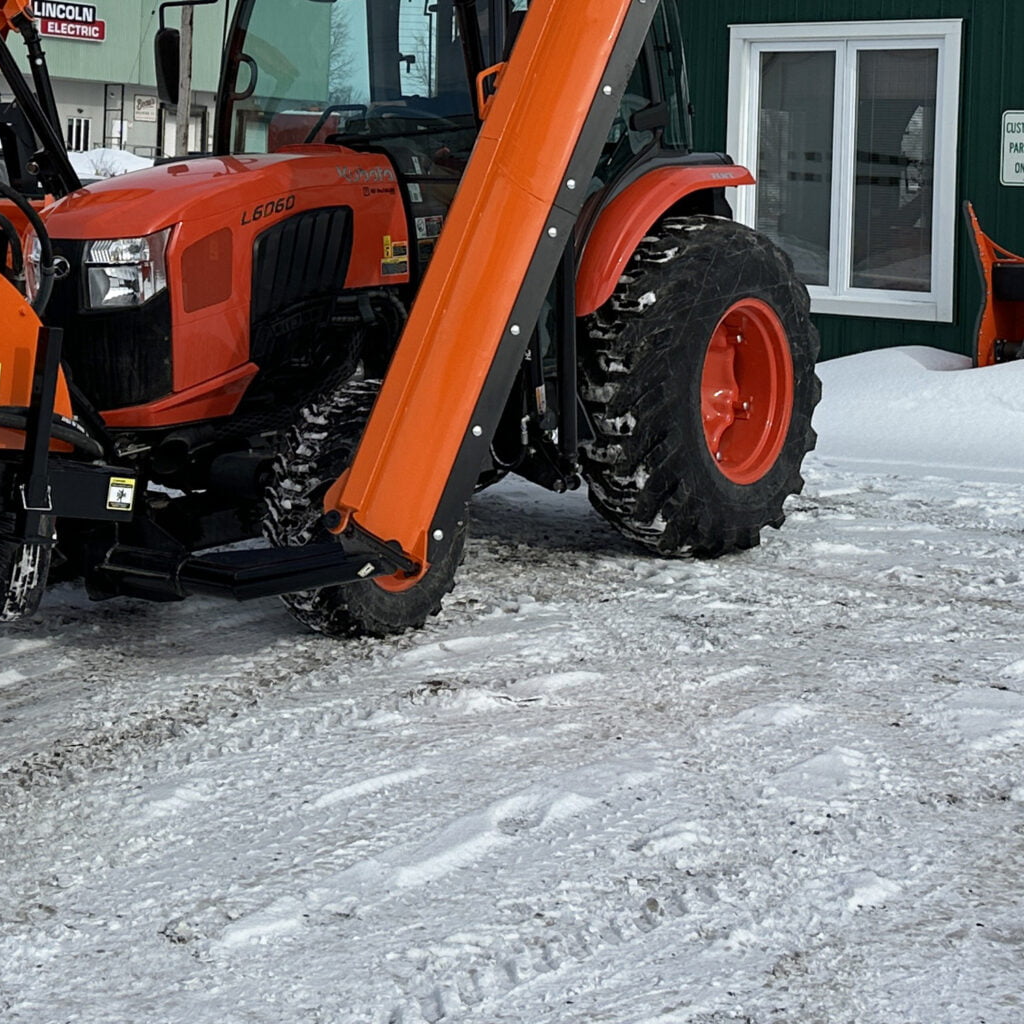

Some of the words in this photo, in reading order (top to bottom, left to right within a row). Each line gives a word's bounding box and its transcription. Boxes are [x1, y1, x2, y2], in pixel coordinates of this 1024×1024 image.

[34, 1, 94, 22] LINCOLN
[47, 21, 100, 38] ELECTRIC
[336, 165, 395, 184] Kubota
[241, 194, 296, 226] L6060
